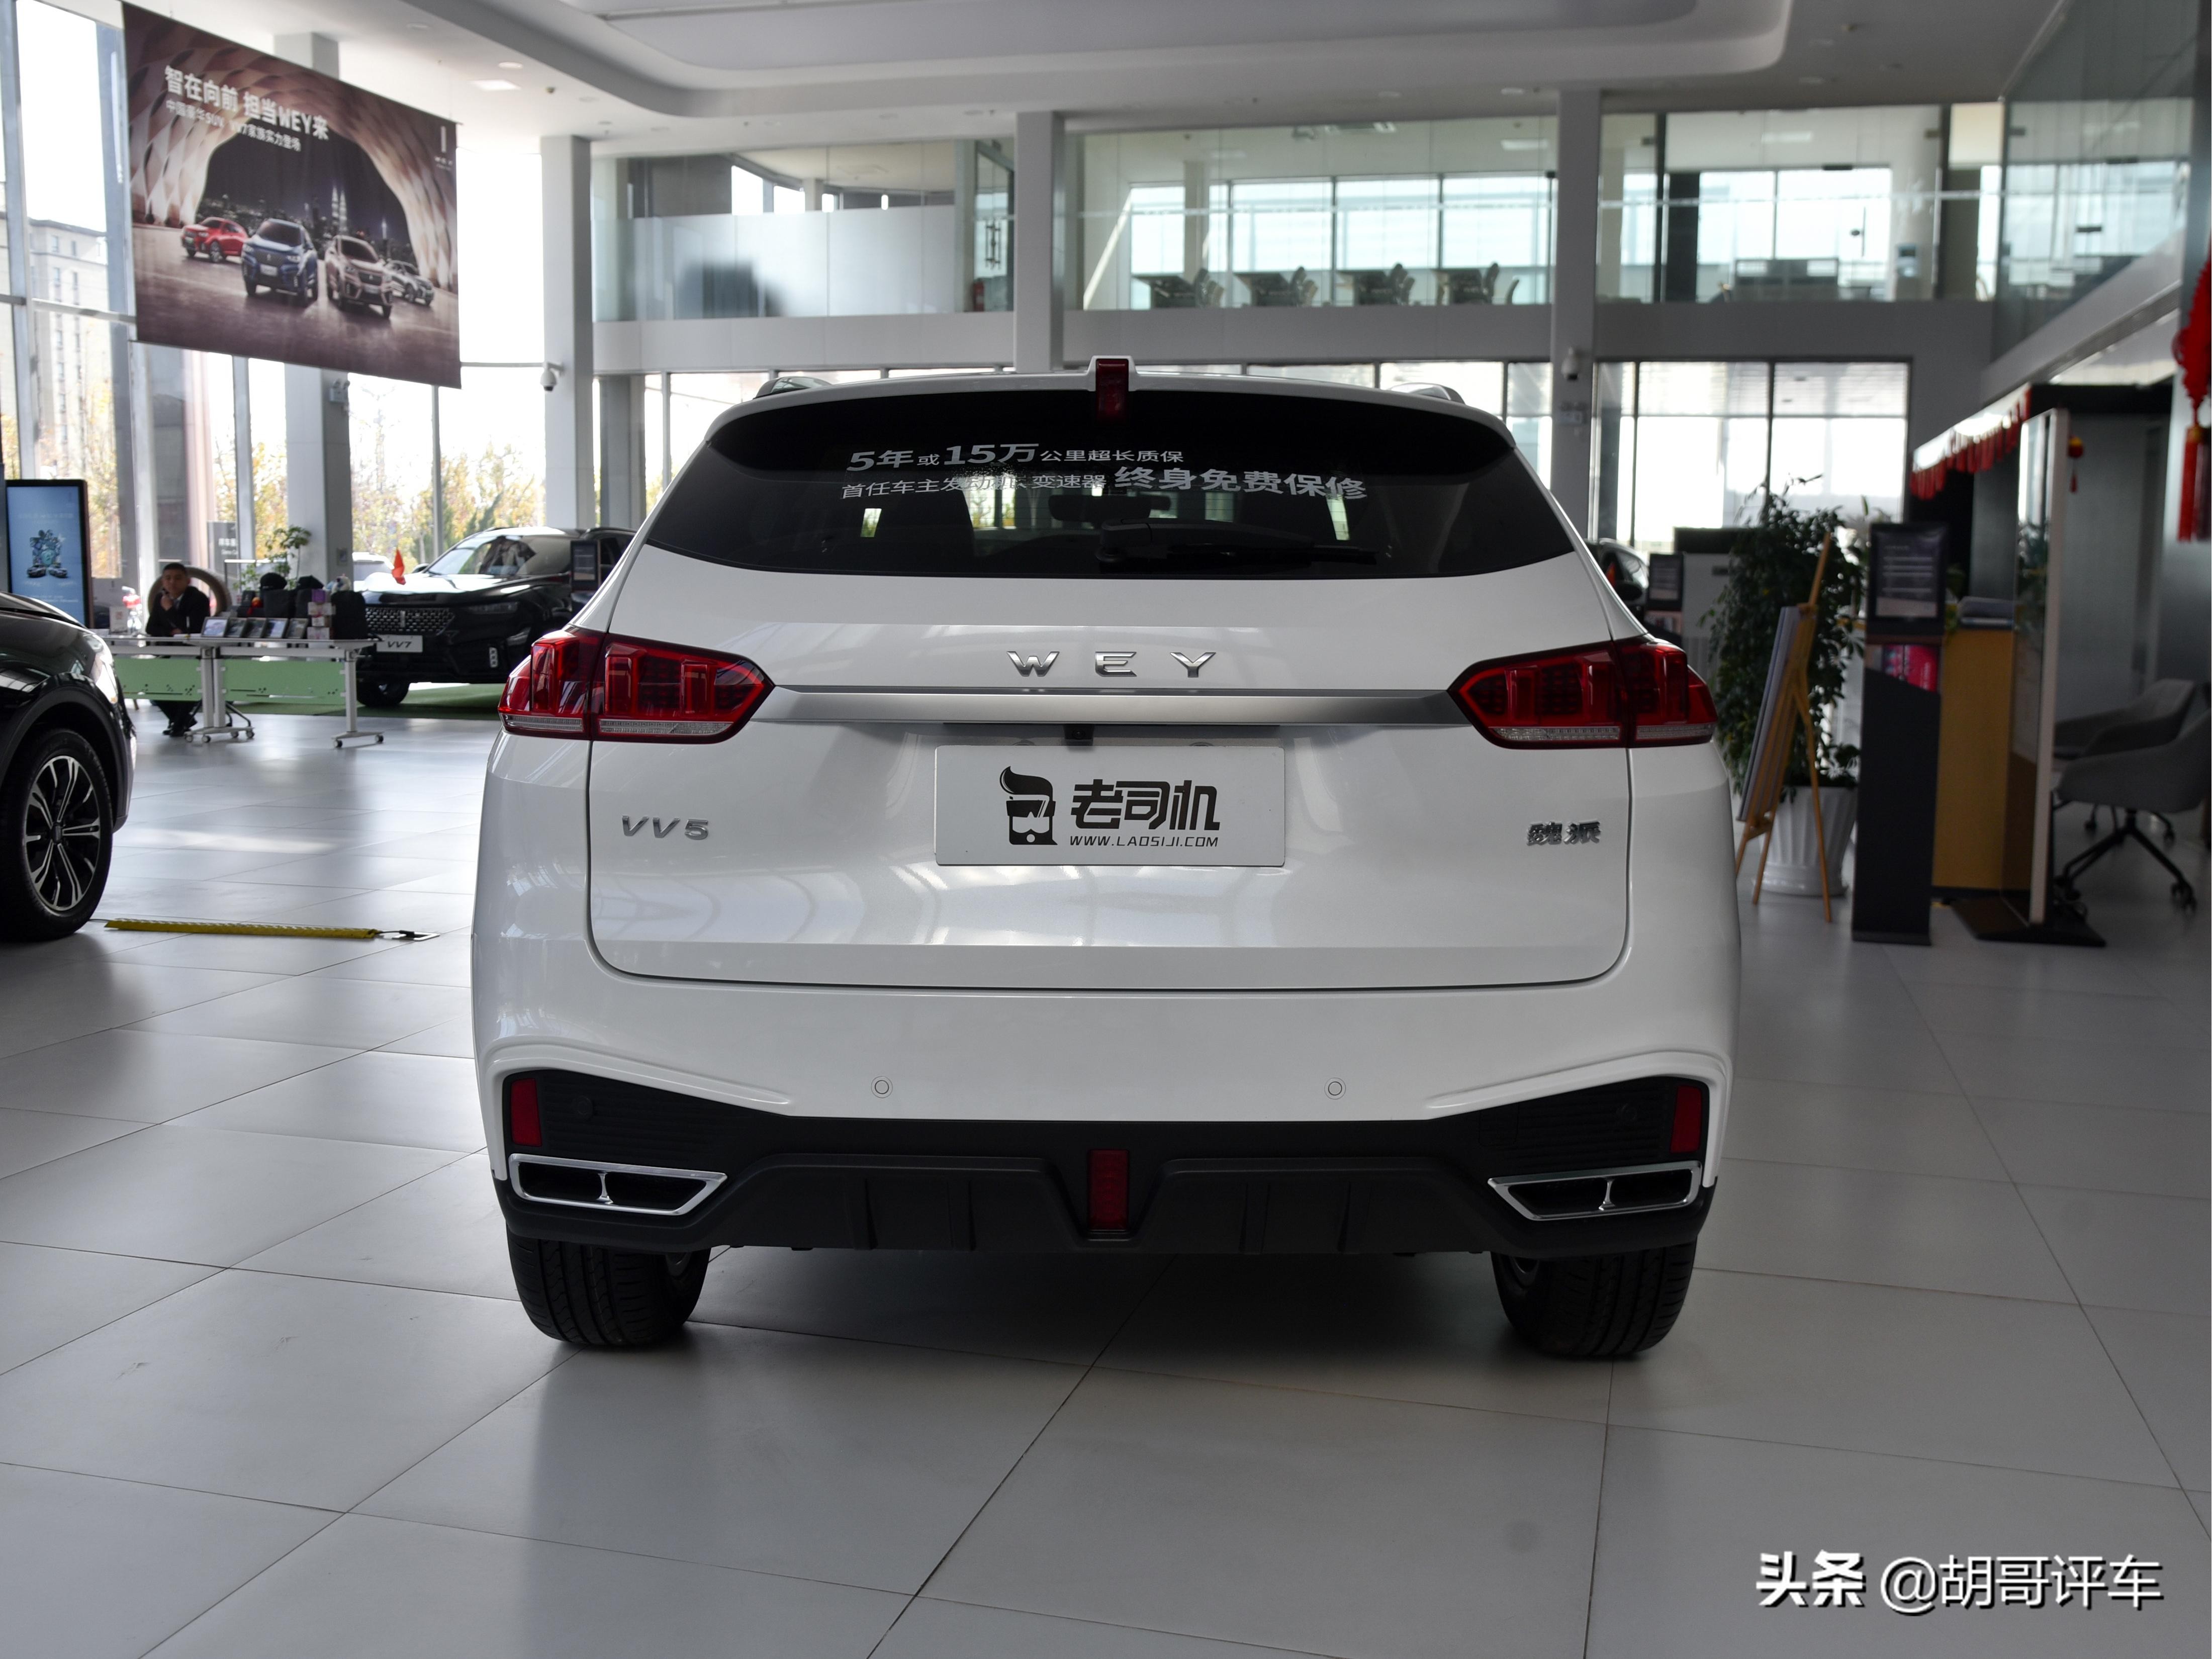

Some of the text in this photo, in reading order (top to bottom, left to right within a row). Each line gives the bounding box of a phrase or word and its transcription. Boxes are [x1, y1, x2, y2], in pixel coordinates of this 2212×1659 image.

[164, 65, 329, 141] 智在向前 担当WEY来
[847, 443, 1184, 472] 5年或15万公里超长质保
[1114, 466, 1368, 500] 终身免费保修
[387, 640, 412, 649] VV7
[1007, 651, 1217, 678] WEY
[1070, 779, 1221, 831] 老司机
[621, 815, 709, 841] VV5
[1069, 835, 1219, 848] WWW.LAOSIJI.COM
[1526, 820, 1601, 846] 魏派
